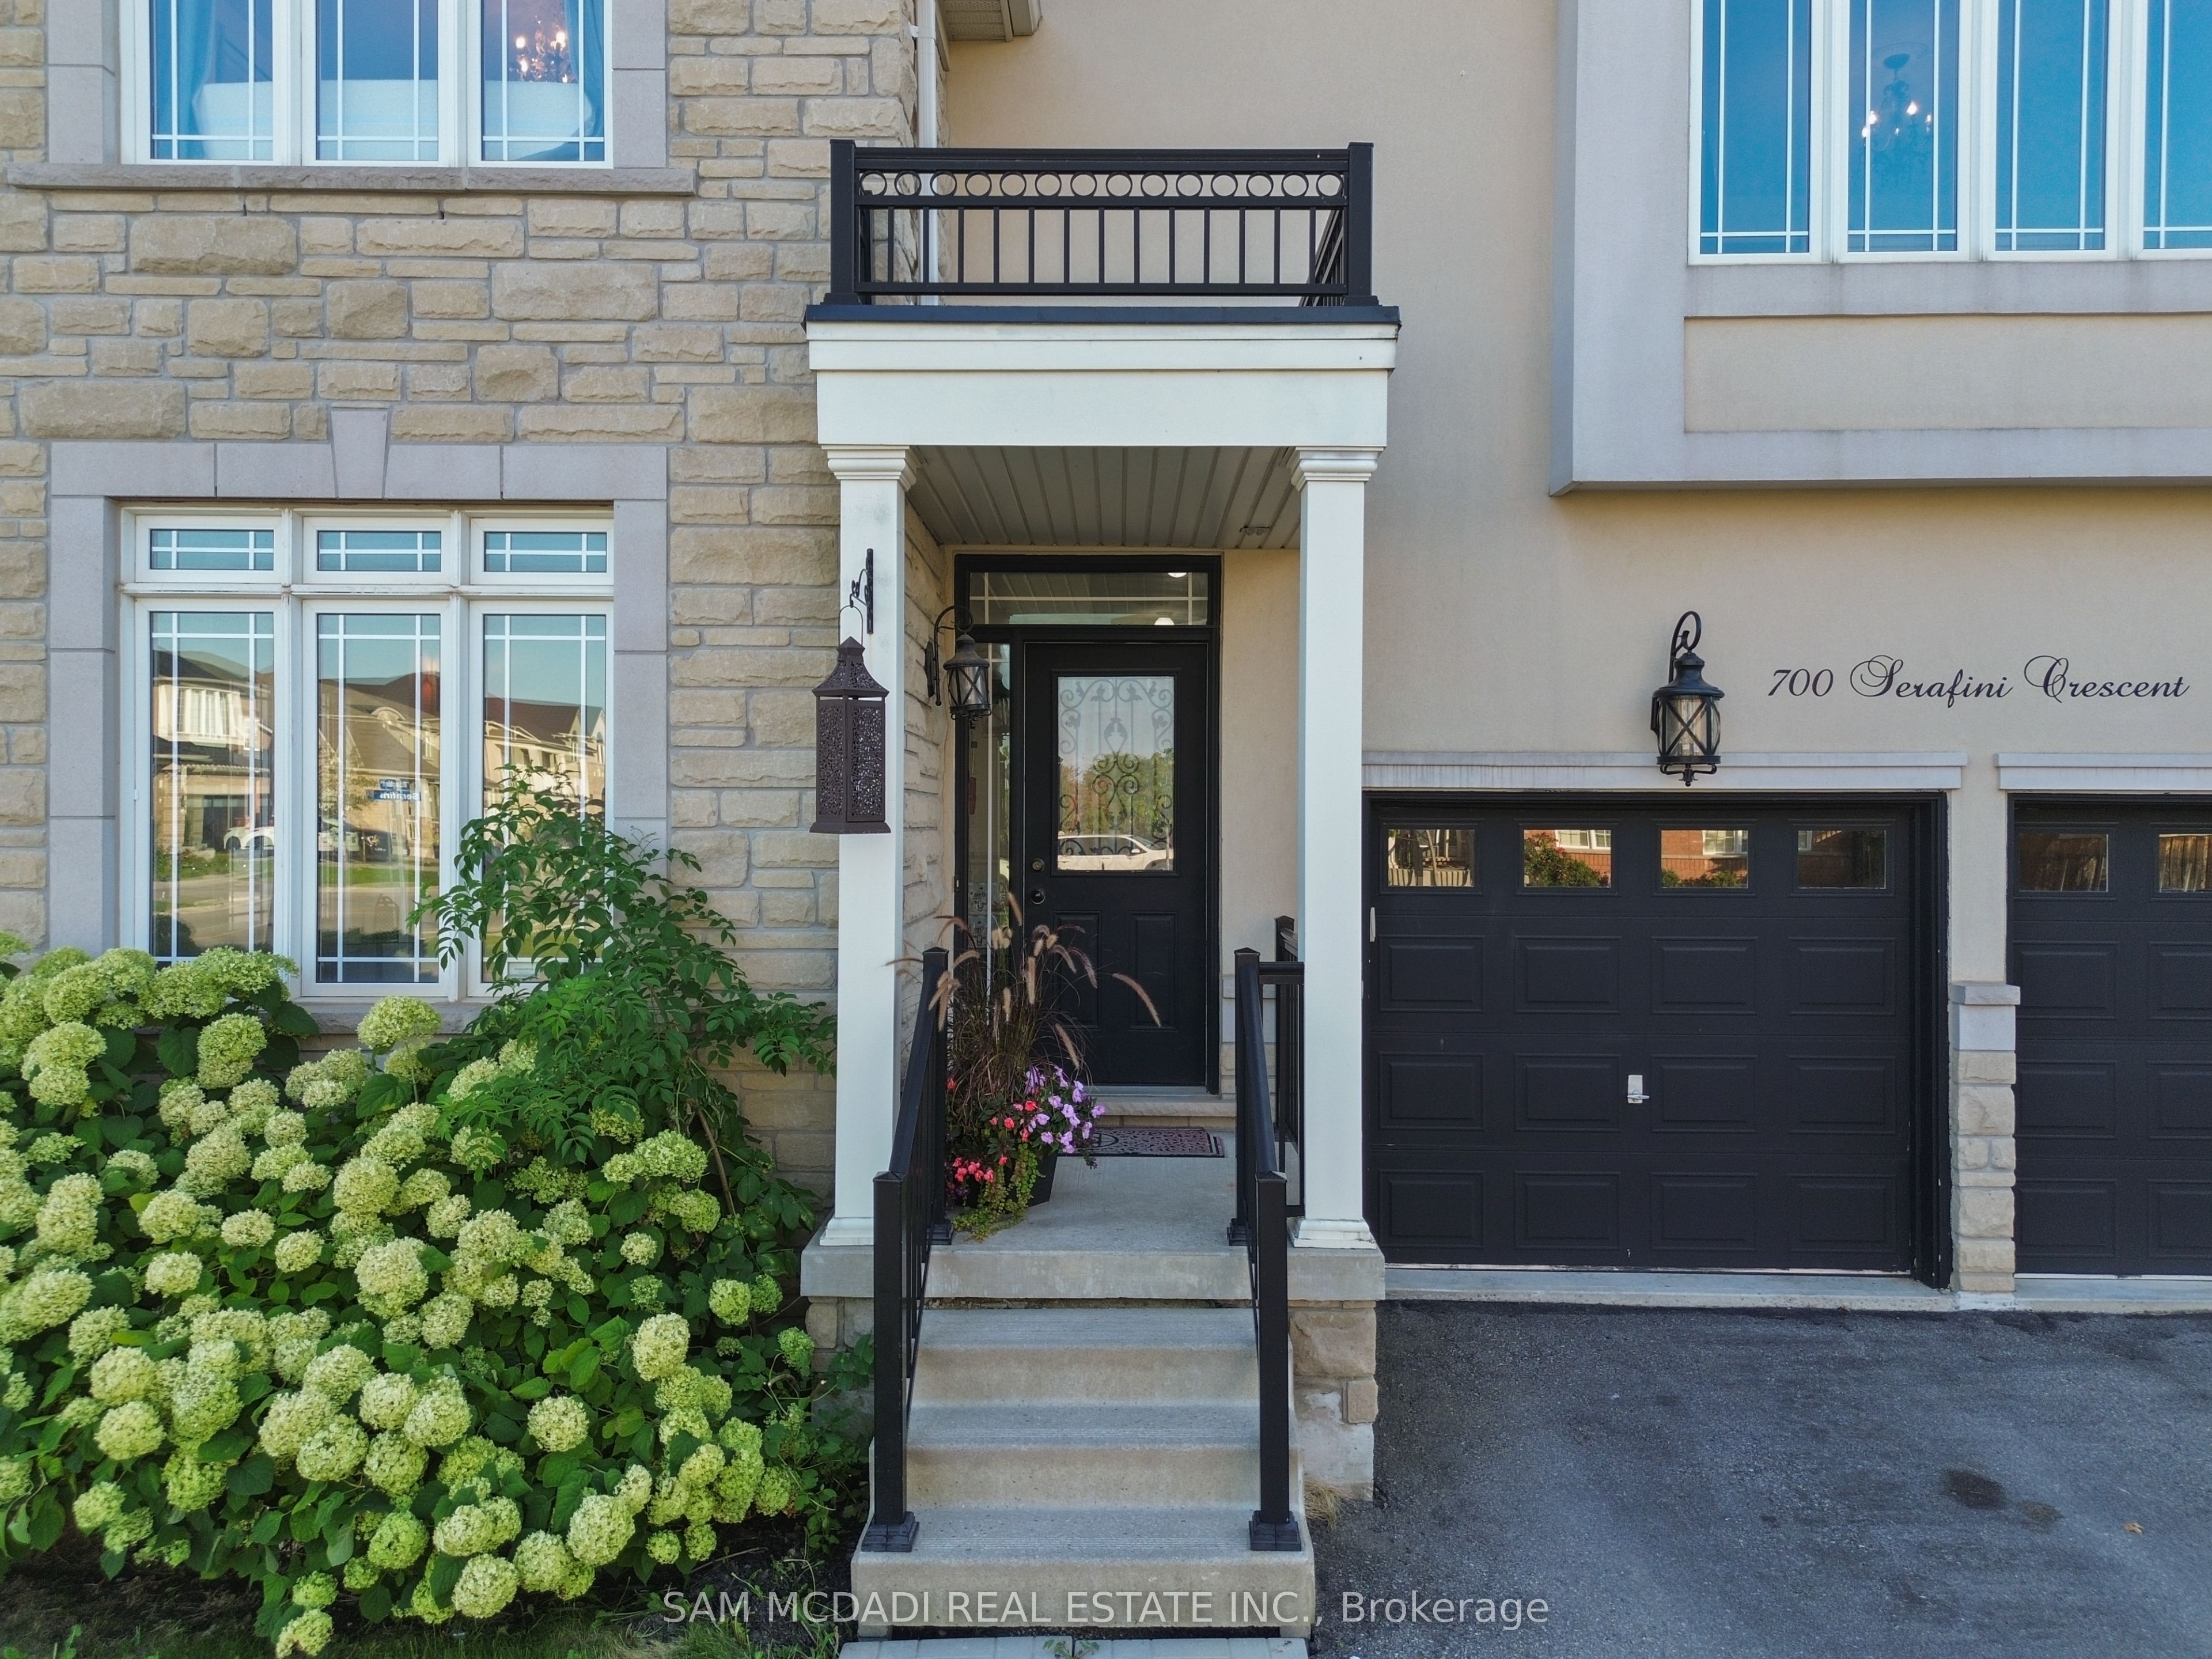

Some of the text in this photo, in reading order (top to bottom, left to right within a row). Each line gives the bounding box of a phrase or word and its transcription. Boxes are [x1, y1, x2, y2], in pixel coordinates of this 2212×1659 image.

[1768, 654, 2190, 709] 700 Serafini Crescent
